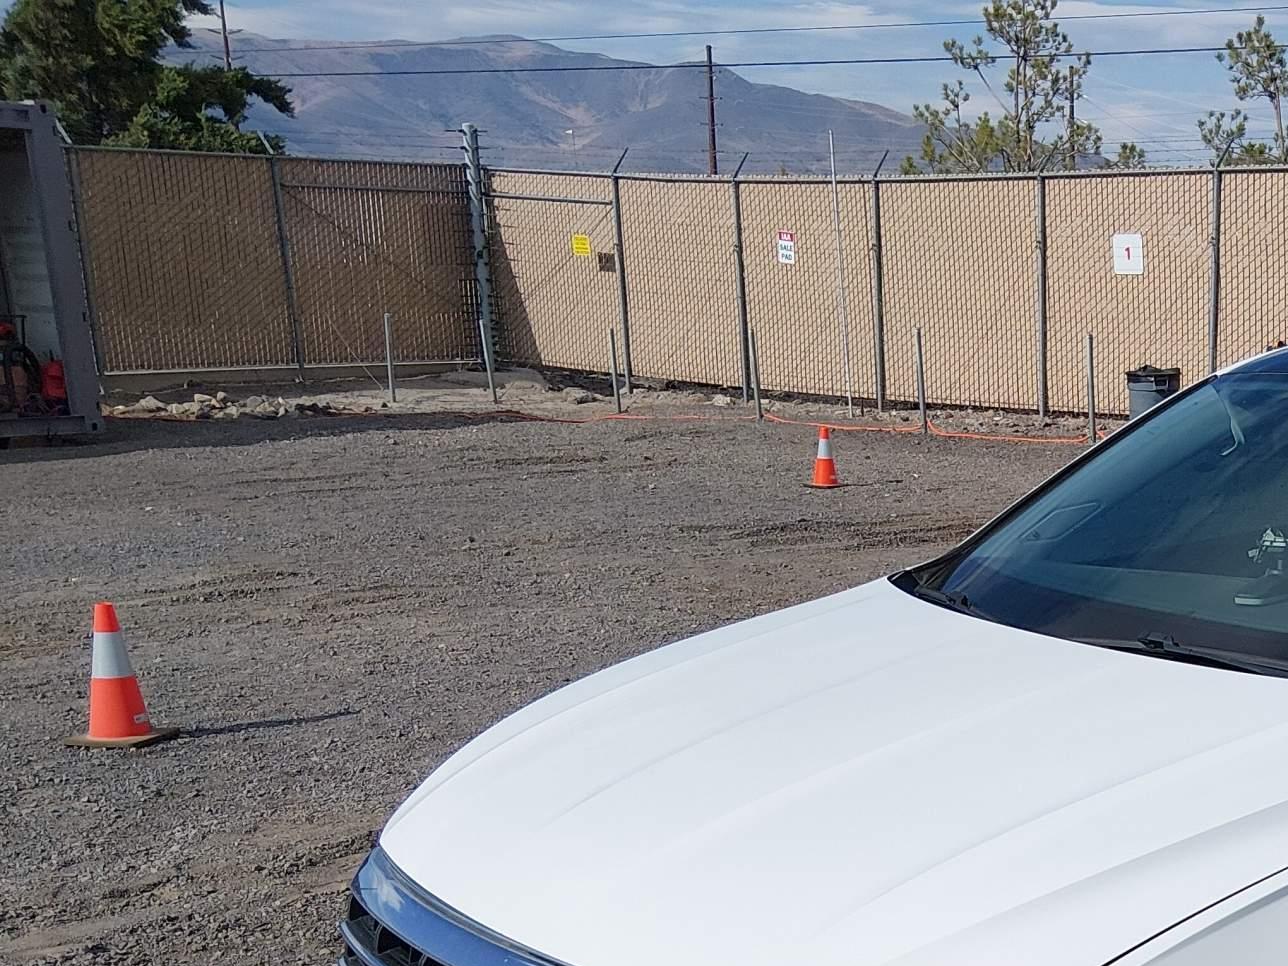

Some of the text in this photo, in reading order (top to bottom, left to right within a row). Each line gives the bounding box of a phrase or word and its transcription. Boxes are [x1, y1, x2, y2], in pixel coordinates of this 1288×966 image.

[780, 244, 793, 252] SALE
[781, 253, 793, 261] PAD
[1124, 246, 1131, 261] 1
